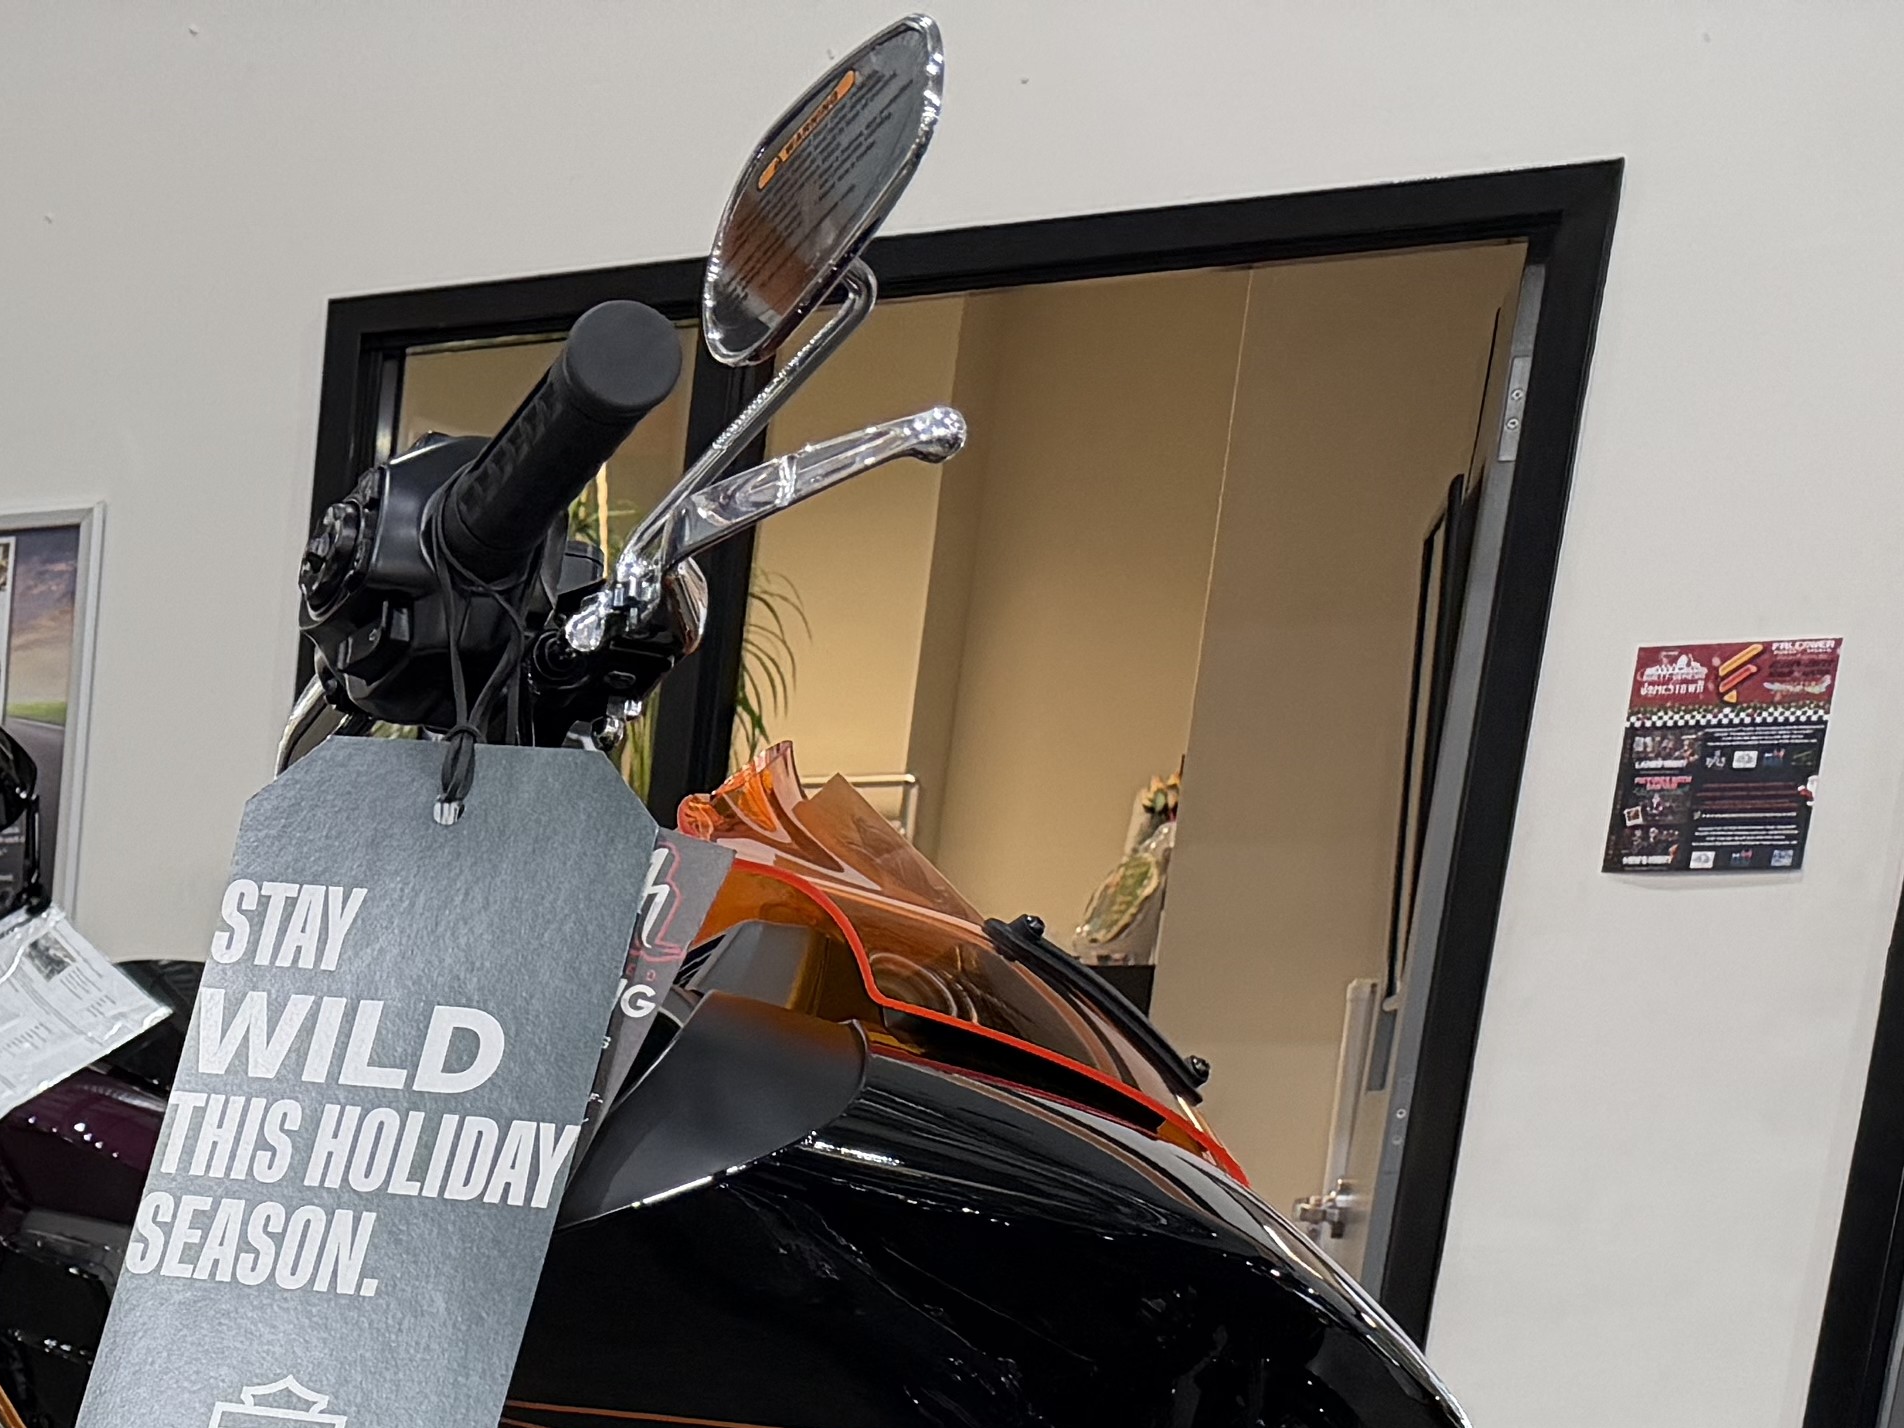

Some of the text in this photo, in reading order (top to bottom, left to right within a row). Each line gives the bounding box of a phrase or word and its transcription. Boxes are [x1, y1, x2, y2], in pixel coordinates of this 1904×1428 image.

[211, 878, 368, 971] STAY
[194, 987, 506, 1093] WILD
[160, 1090, 581, 1210] THIS HOLIDAY
[125, 1190, 379, 1297] SEASON.
